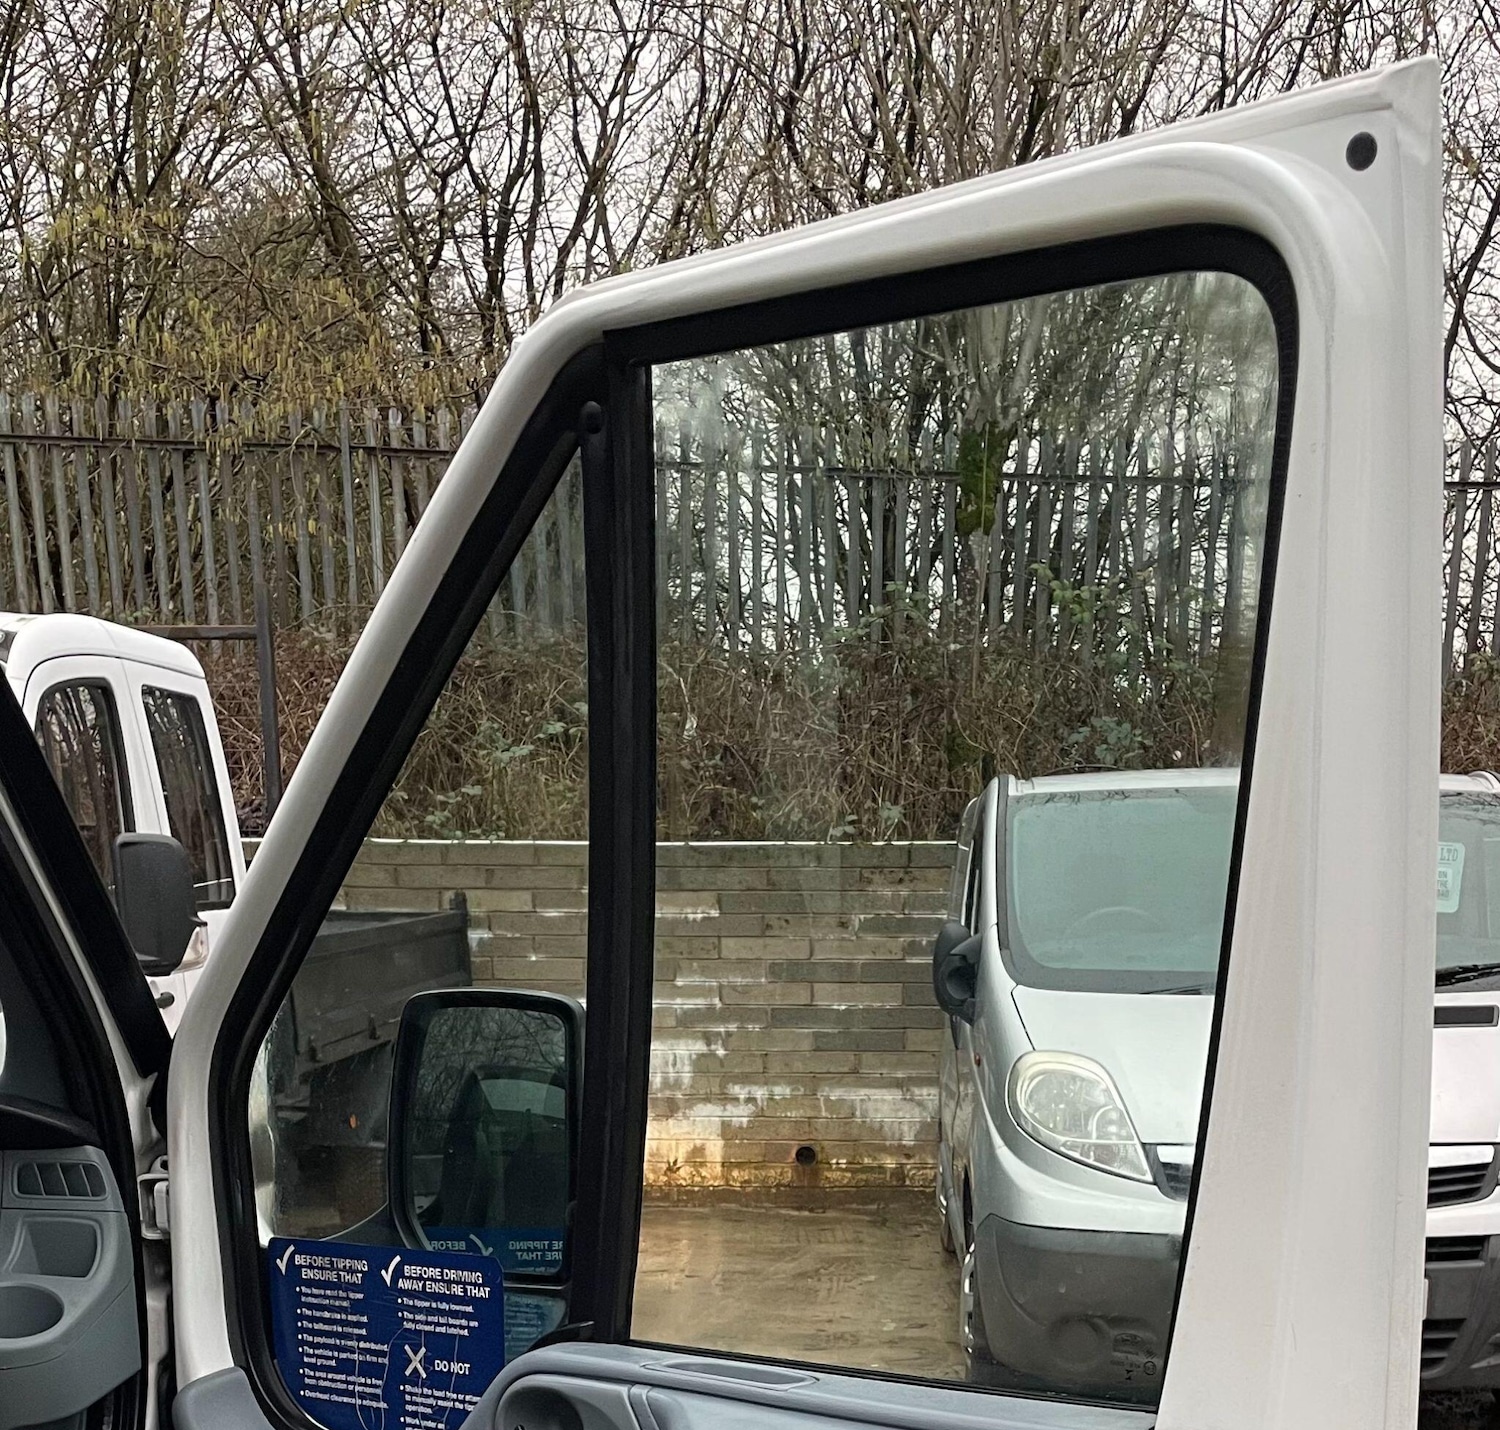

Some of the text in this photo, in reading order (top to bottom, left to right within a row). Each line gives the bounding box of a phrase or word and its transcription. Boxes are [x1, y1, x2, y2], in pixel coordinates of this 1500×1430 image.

[1439, 847, 1459, 862] LTD
[295, 1254, 368, 1271] BEFORE TIPPING
[301, 1267, 363, 1284] ENSURE THAT
[403, 1265, 483, 1284] BEFORE DRIVING
[397, 1278, 491, 1299] AWAY ENSURE THAT
[435, 1360, 470, 1375] DO NOT
